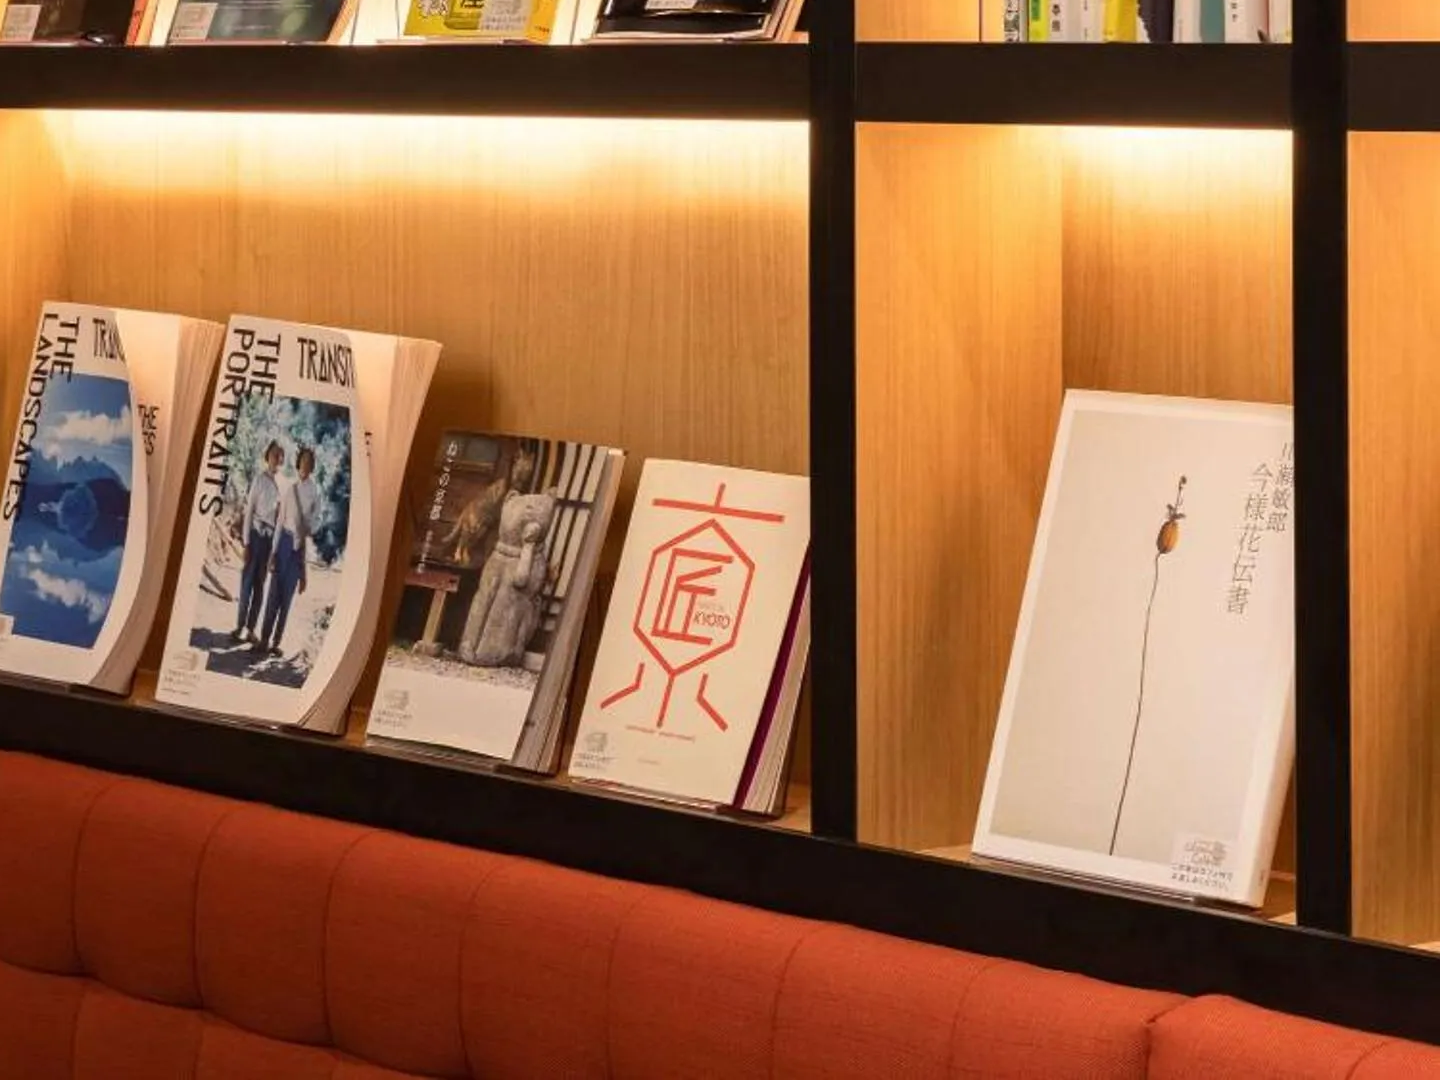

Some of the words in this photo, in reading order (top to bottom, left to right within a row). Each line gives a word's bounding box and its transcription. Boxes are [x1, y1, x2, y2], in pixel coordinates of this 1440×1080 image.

[50, 316, 80, 383] THE
[250, 333, 281, 405] THE
[3, 313, 59, 521] LANDSCAPES
[198, 328, 255, 518] PORTRAITS
